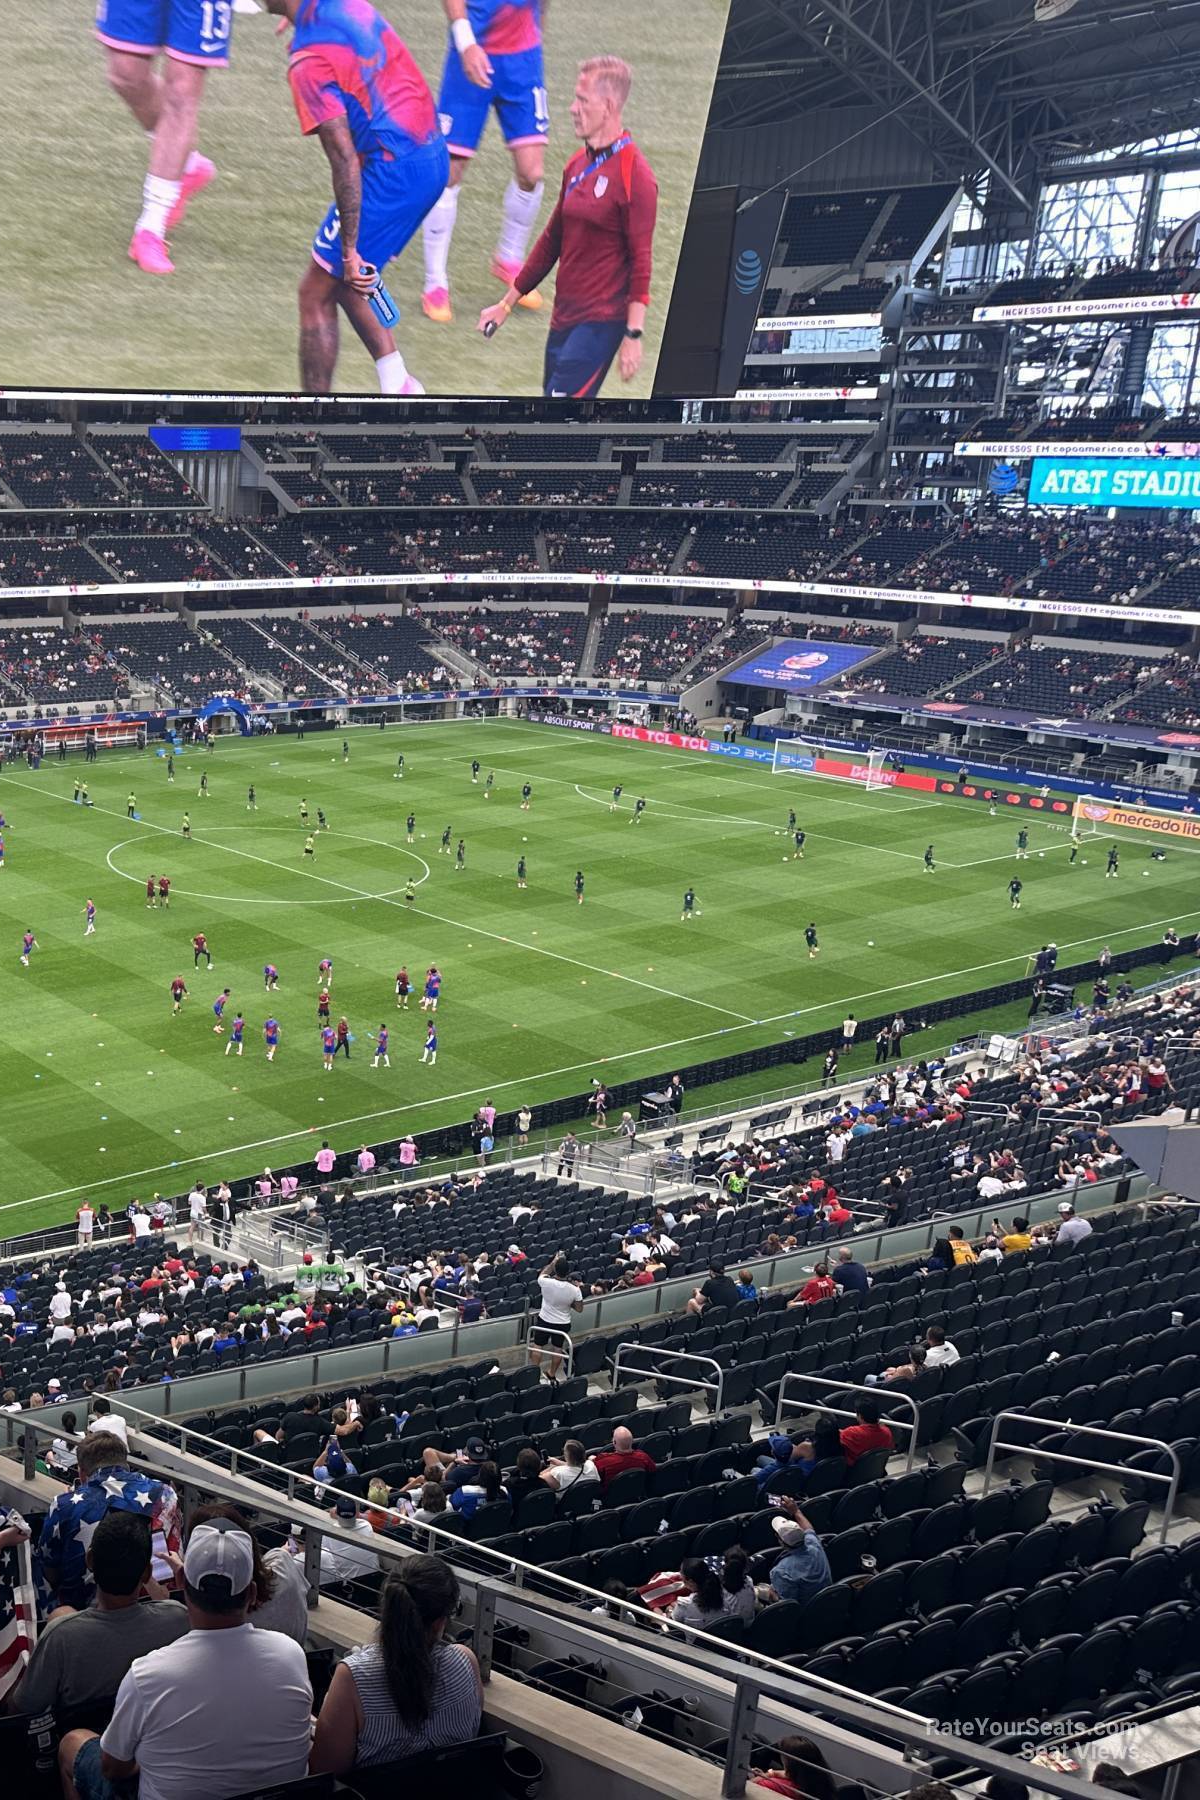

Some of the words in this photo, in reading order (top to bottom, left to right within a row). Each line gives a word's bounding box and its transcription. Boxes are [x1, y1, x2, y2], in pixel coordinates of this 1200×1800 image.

[200, 1, 231, 39] 13
[1001, 306, 1053, 317] INGRESSOS
[1057, 305, 1071, 313] EM
[982, 445, 1032, 453] INGRESSOS
[1041, 469, 1108, 494] AT&T
[544, 716, 572, 728] ABSOLUT
[573, 720, 594, 730] SPORT
[613, 725, 640, 740] TCL
[647, 730, 673, 745] TCL
[680, 736, 708, 750] TCL
[710, 742, 740, 755] BYD
[744, 748, 774, 761] BYD
[1114, 812, 1180, 832] mercado
[307, 1272, 313, 1283] 9
[325, 1271, 337, 1282] 22
